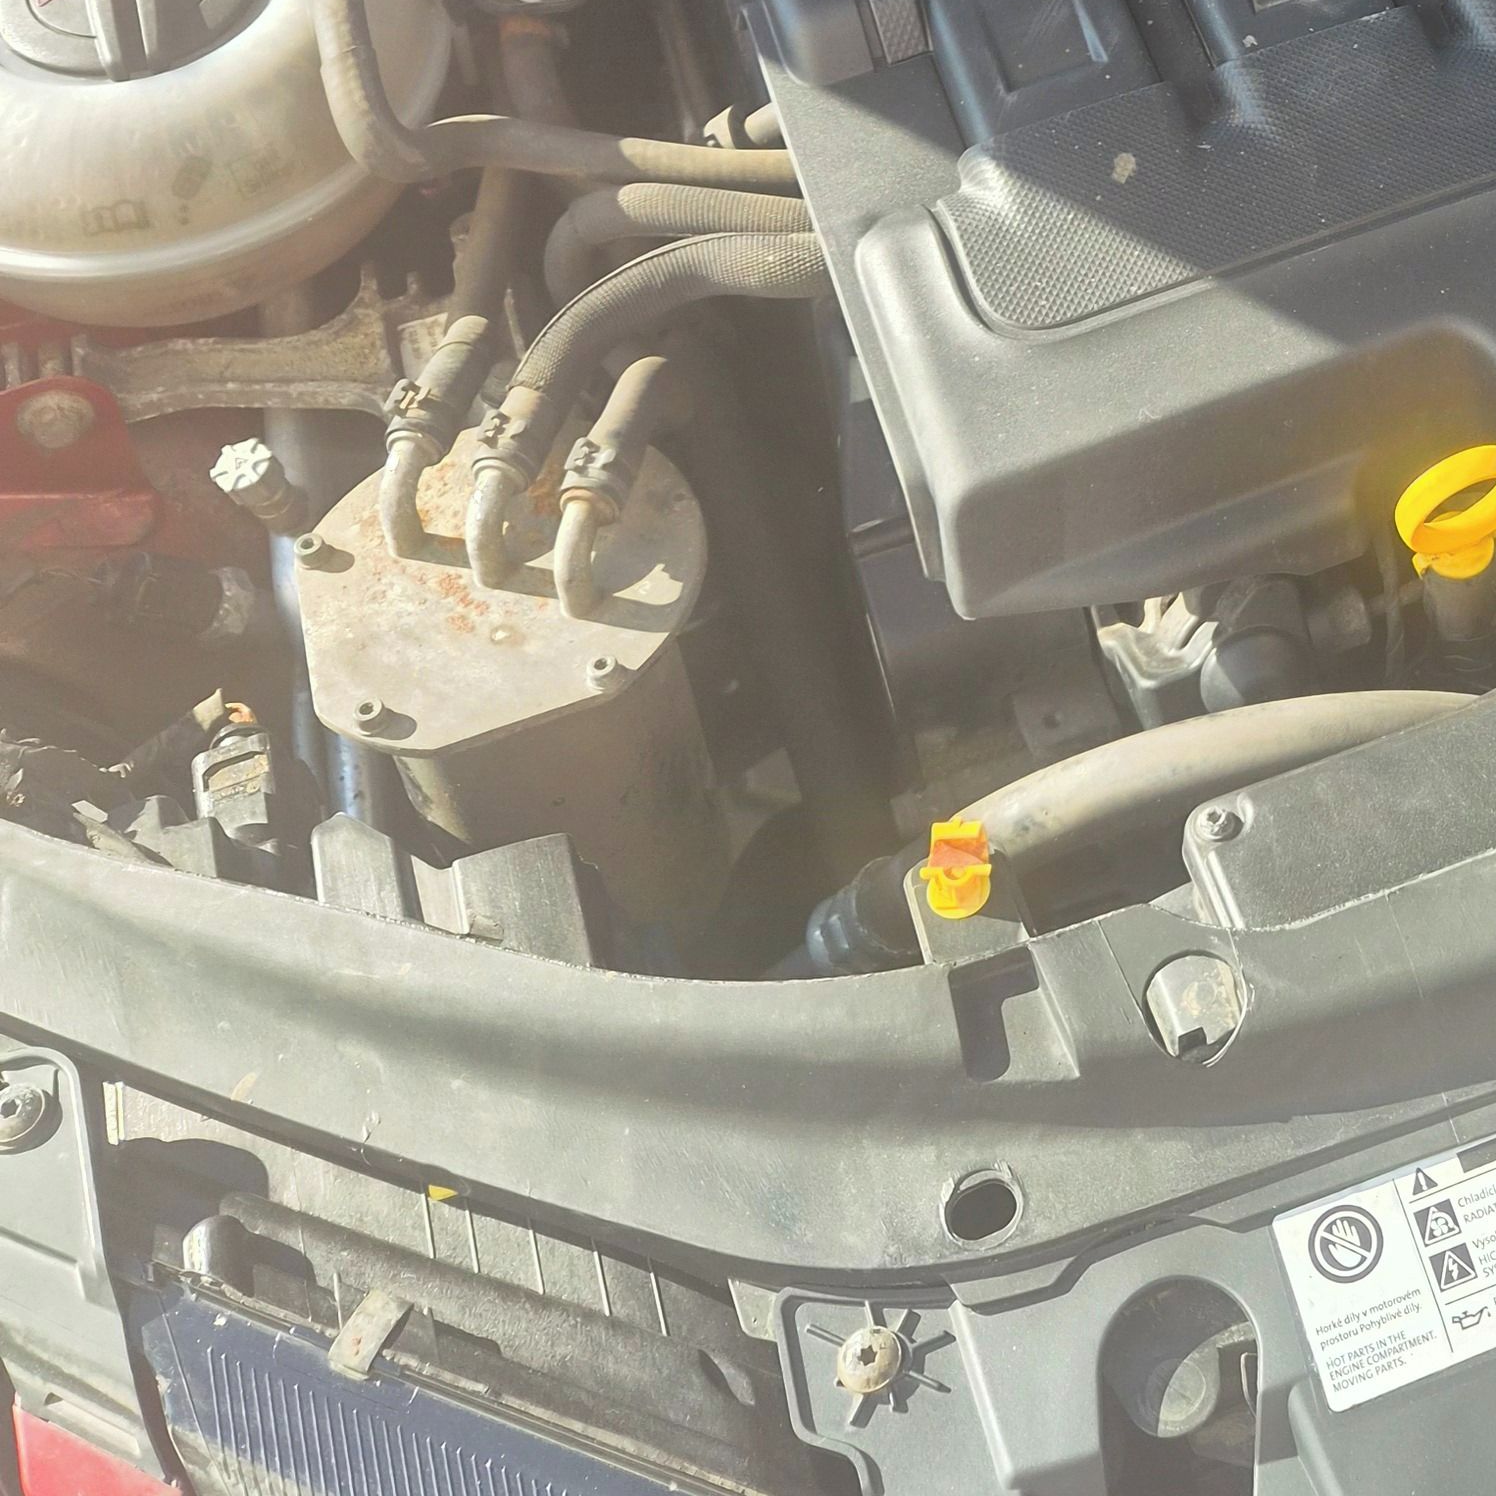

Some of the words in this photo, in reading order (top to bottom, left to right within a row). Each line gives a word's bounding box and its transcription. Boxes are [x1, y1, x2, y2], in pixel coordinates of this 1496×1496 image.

[1320, 1328, 1359, 1352] prostoru
[1325, 1354, 1346, 1370] HOT
[1347, 1343, 1375, 1361] PARTS
[1375, 1338, 1387, 1350] IN
[1387, 1330, 1406, 1344] THE
[1329, 1358, 1365, 1381] ENGINE
[1366, 1330, 1437, 1366] COMPARTMENT.
[1332, 1369, 1373, 1392] MOVING
[1374, 1356, 1407, 1376] PARTS.
